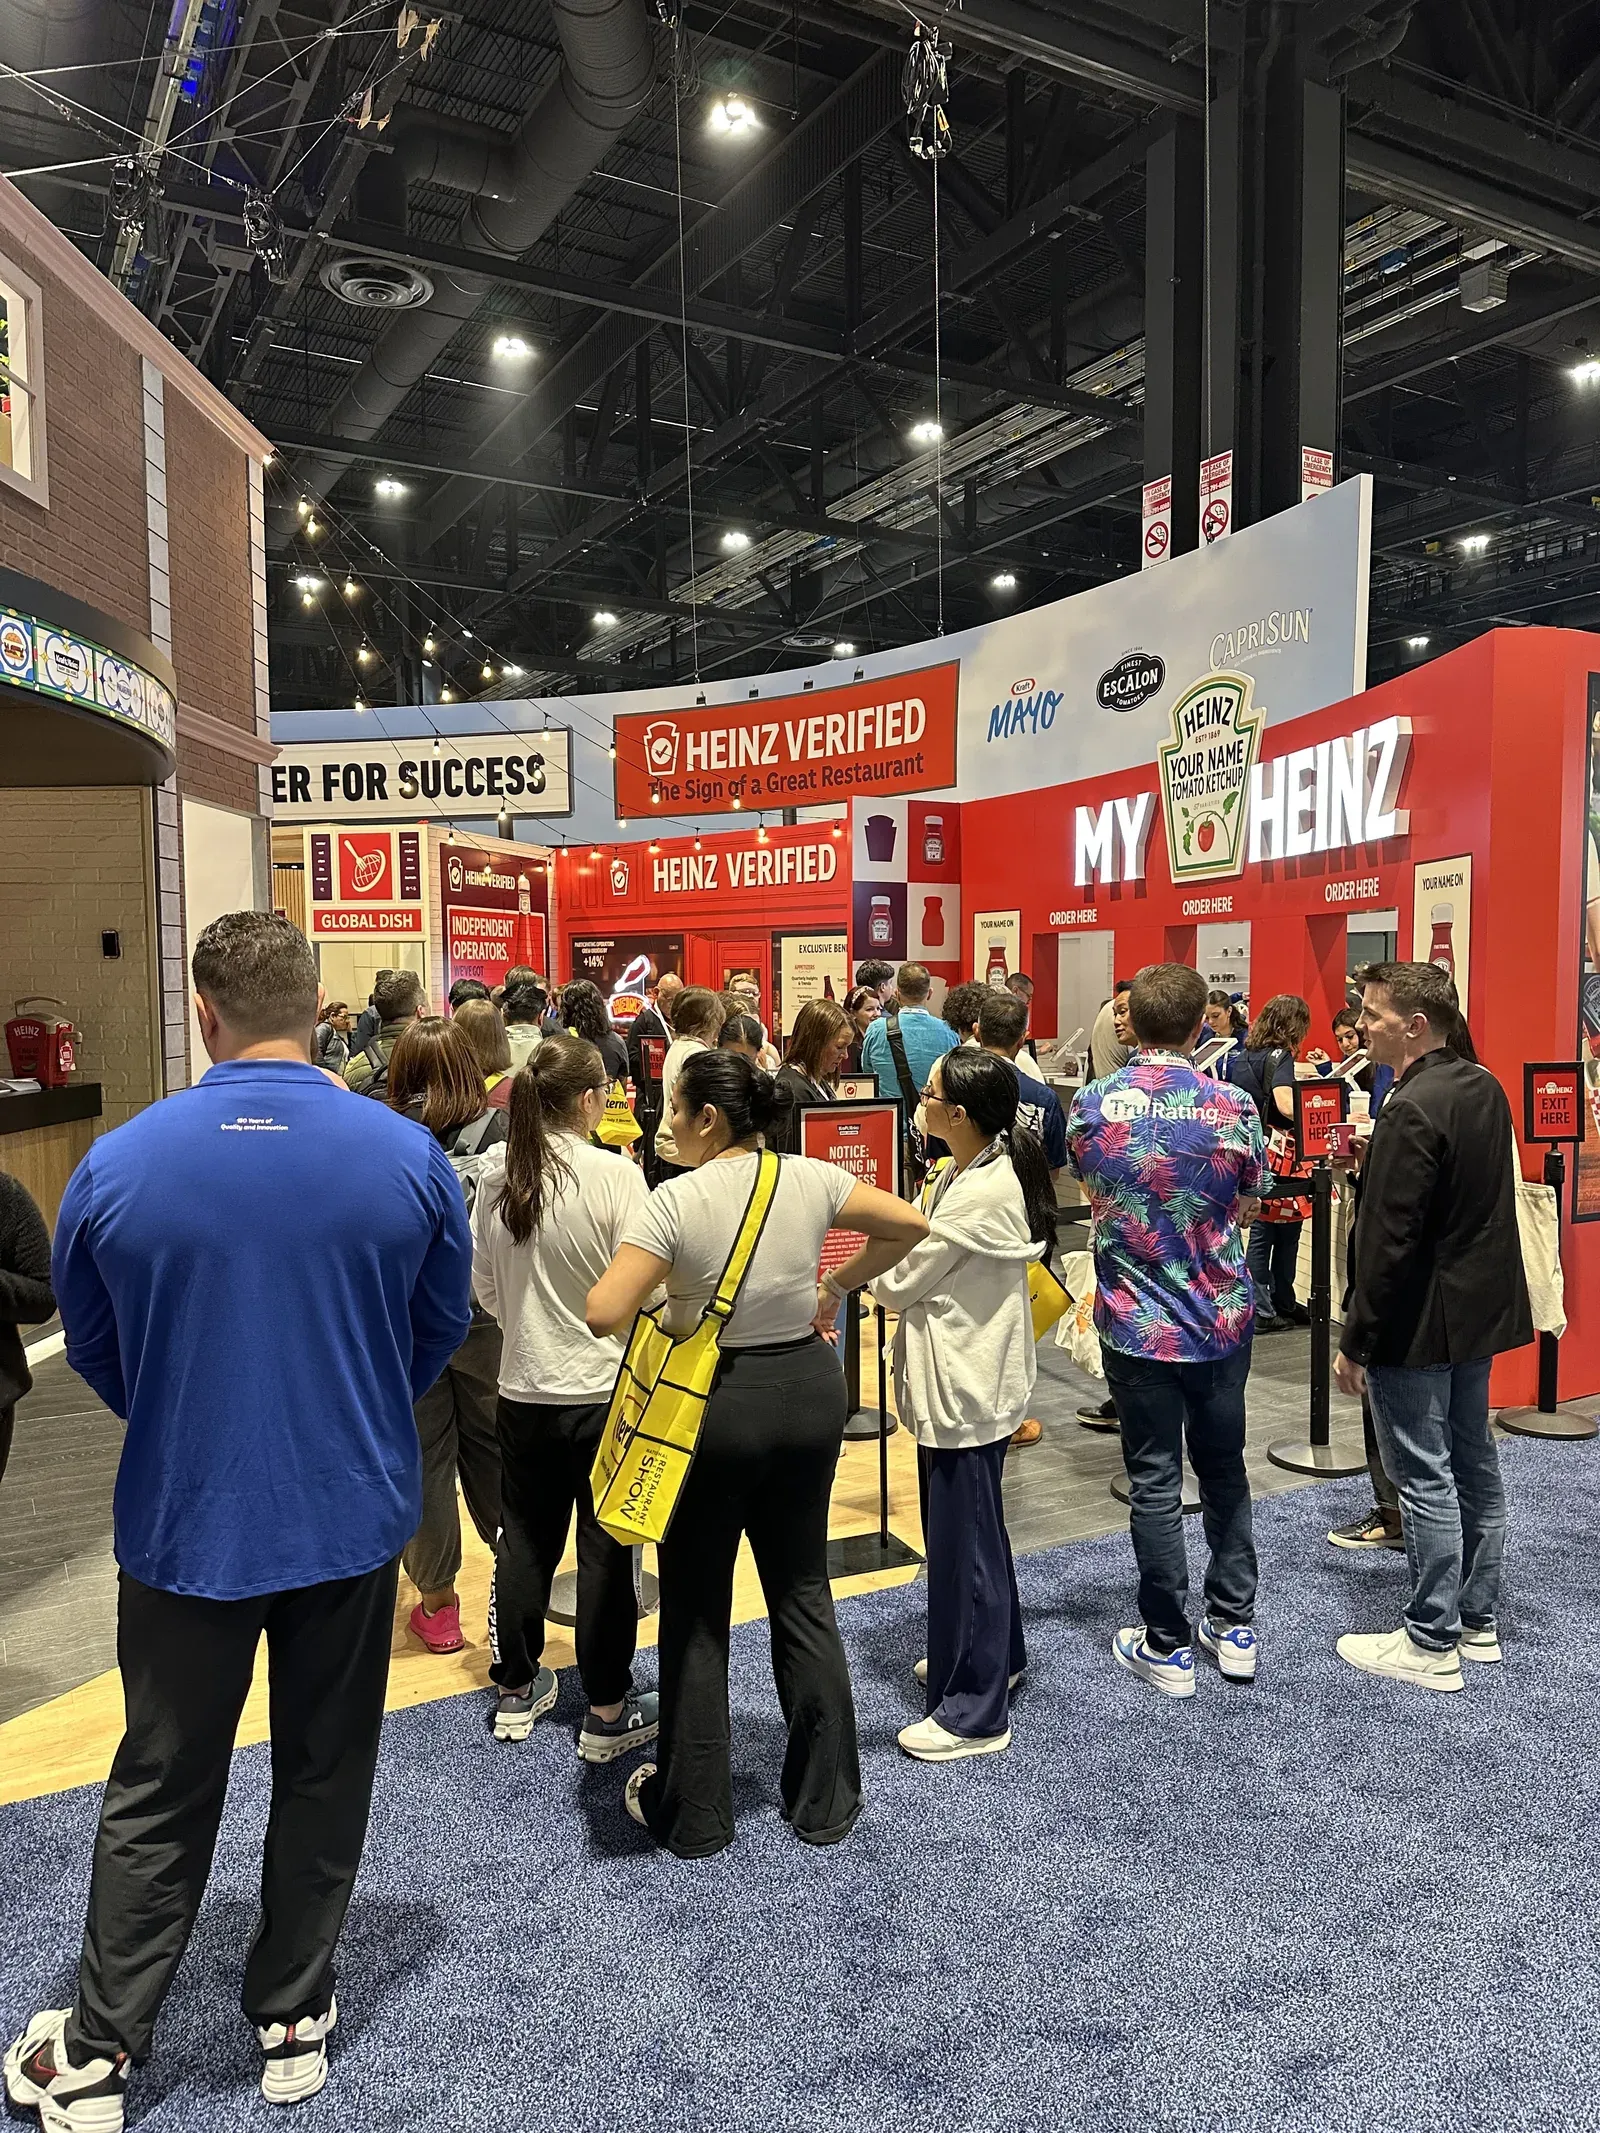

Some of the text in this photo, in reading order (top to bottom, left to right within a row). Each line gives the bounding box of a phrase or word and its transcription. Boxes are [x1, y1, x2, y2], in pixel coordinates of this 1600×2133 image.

[1304, 461, 1331, 473] EMERGENCY
[1311, 456, 1322, 464] CASE
[1121, 659, 1142, 671] FINEST
[1015, 681, 1031, 692] Kraft
[1103, 667, 1158, 698] ESCALON
[1116, 691, 1144, 706] TOMATOES
[987, 690, 1065, 743] MAYO
[1184, 696, 1234, 739] HEINZ
[686, 698, 926, 772] HEINZ VERIFIED
[1208, 730, 1221, 739] 1869
[1170, 739, 1244, 781] YOUR NAME
[322, 762, 388, 802] FOR
[398, 753, 547, 800] SUCCESS
[648, 752, 924, 804] The Sign of a Great Restaurant
[1171, 766, 1244, 802] TOMATO KETCHUP
[1074, 716, 1411, 886] MY HEINZ
[653, 843, 838, 893] HEINZ VERIFIED
[487, 874, 516, 890] VERIFIED
[1422, 872, 1464, 891] YOUR NAME ON
[1325, 877, 1379, 903] ORDER HERE
[1182, 896, 1233, 916] ORDER HERE
[321, 913, 413, 929] GLOBAL DISH
[980, 919, 1014, 929] YOUR NAME ON
[1049, 908, 1098, 926] ORDER HERE
[452, 916, 514, 938] INDEPENDENT
[452, 940, 509, 962] OPERATORS,
[799, 943, 848, 954] EXCLUSIVE BEN
[472, 965, 484, 977] GOT
[613, 996, 644, 1016] HEINZ
[13, 1025, 40, 1037] HEINZ
[1556, 1086, 1573, 1094] HEINZ
[1321, 1099, 1336, 1107] HEINZ
[1542, 1098, 1568, 1110] EXIT
[1309, 1111, 1331, 1125] EXIT
[1540, 1112, 1570, 1124] HERE
[220, 1124, 243, 1132] Quality
[1308, 1127, 1328, 1140] HER
[1330, 1128, 1338, 1151] COSTA
[829, 1145, 869, 1159] NOTICE:
[866, 1159, 877, 1172] IN
[646, 1448, 669, 1460] NATIONAL
[620, 1455, 654, 1521] SHOW
[637, 1459, 667, 1526] RESTAURANT
